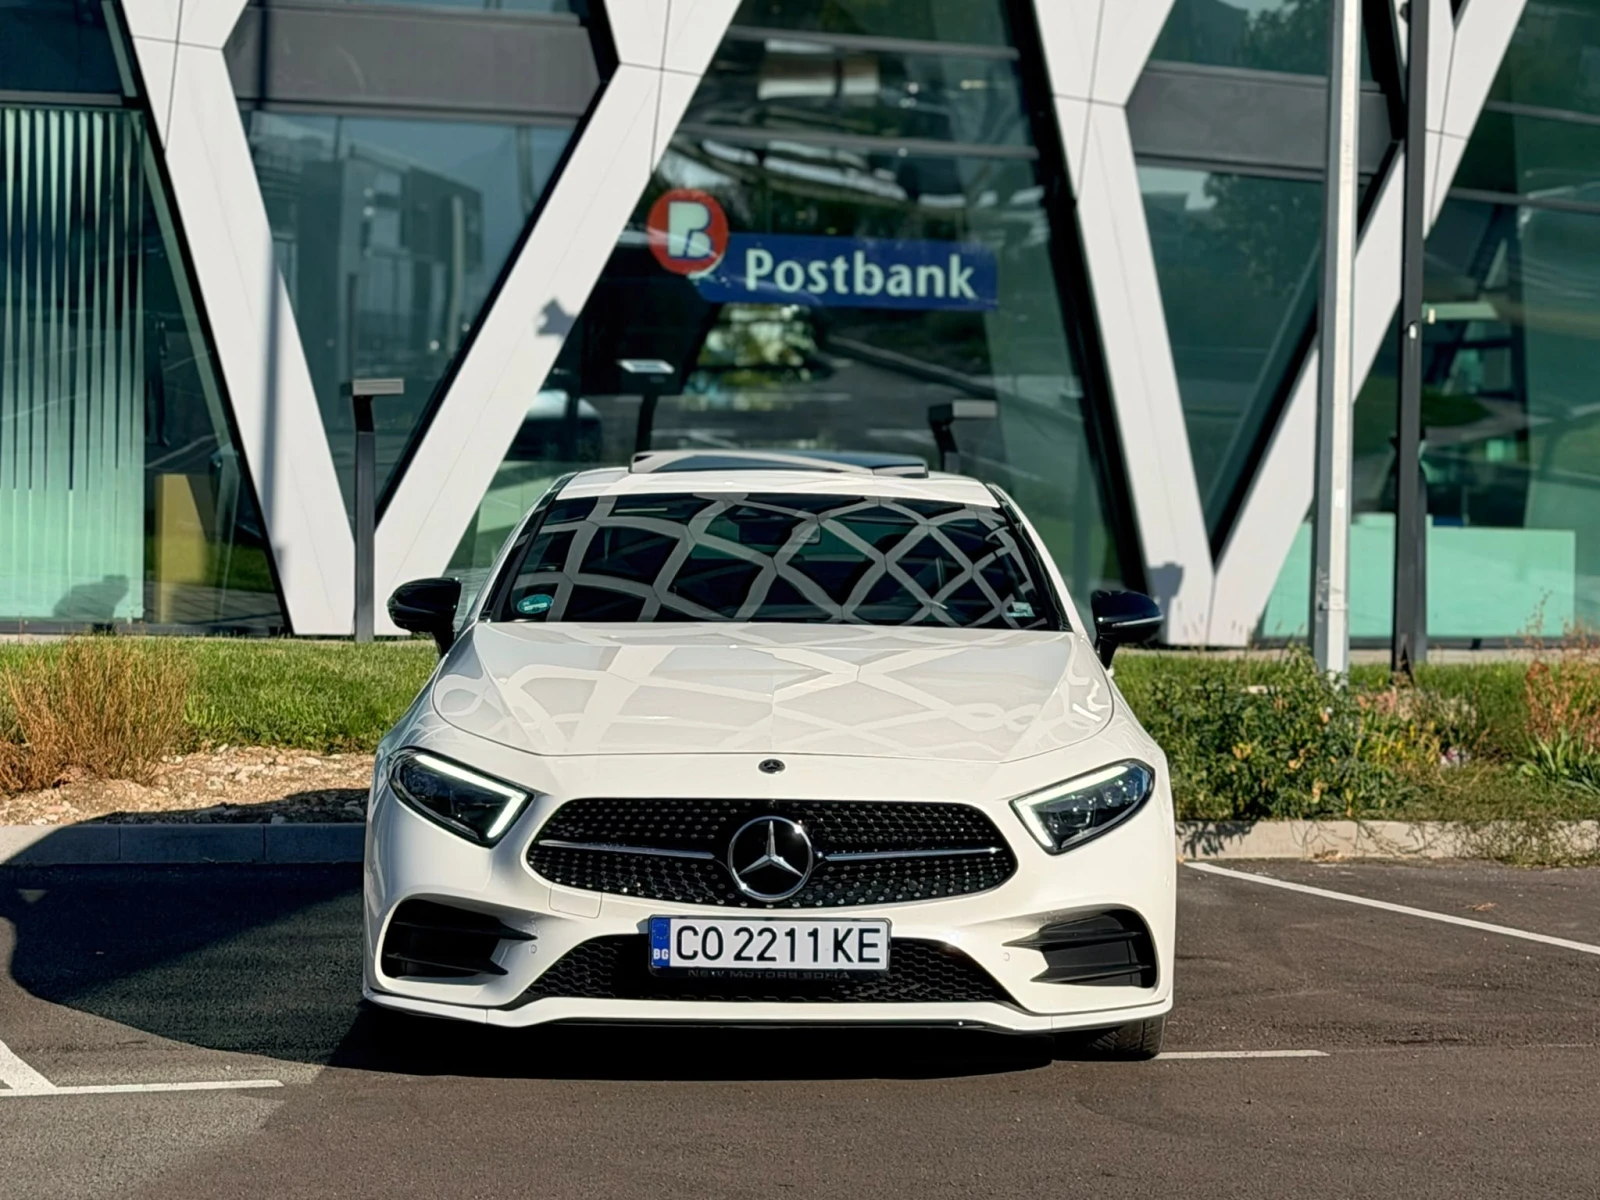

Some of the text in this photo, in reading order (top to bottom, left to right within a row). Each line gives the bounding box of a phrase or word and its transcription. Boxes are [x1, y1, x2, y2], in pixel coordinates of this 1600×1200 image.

[745, 248, 978, 300] Postbank
[653, 948, 669, 960] BG
[676, 925, 880, 964] CO 2211 KE
[729, 970, 796, 980] MOTORS
